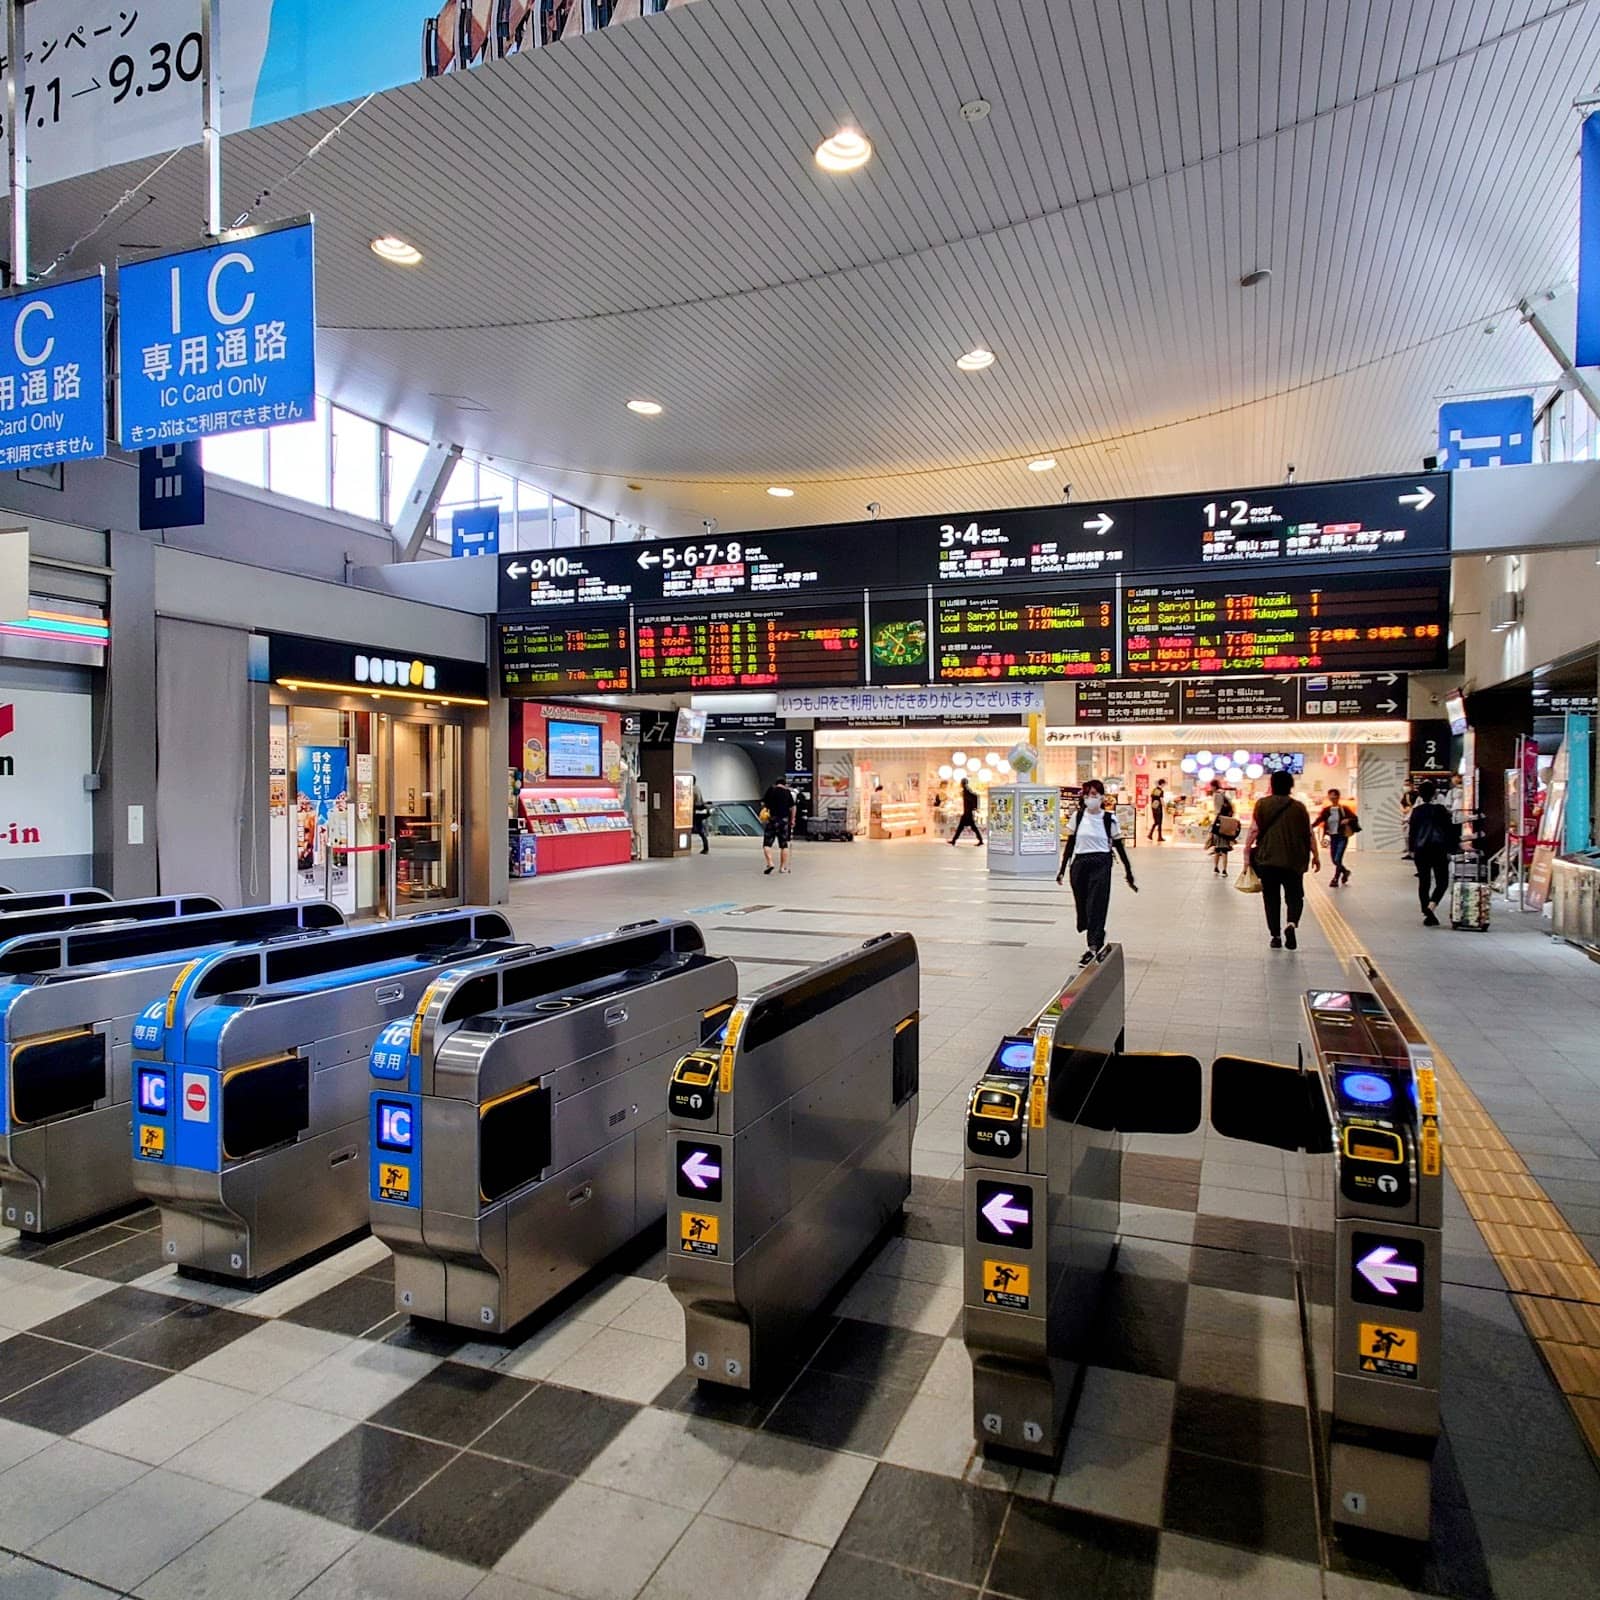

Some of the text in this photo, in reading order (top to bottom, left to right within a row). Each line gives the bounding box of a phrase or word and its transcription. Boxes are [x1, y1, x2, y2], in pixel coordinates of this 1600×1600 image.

[109, 32, 202, 104] 9.30
[141, 321, 287, 382] 専用通路
[161, 373, 267, 407] IC Card Only
[30, 410, 64, 434] Only
[131, 403, 303, 442] きっぷはご利用できません
[940, 612, 960, 623] Local
[1000, 609, 1018, 619] Line
[1100, 604, 1109, 615] 3
[1128, 603, 1149, 614] Local
[1195, 600, 1215, 610] Line
[1128, 615, 1149, 626] Local
[1195, 612, 1215, 622] Line
[1253, 608, 1298, 620] Fukuyama
[940, 623, 960, 634] Local
[1000, 620, 1018, 631] Line
[1100, 616, 1109, 627] 3
[1100, 651, 1109, 662] 3
[1128, 650, 1149, 661] Local
[1194, 648, 1215, 657] Line
[354, 654, 436, 690] DOUTOR
[781, 690, 1041, 712] いつもJRをご利用いただきありがとうございます。
[795, 736, 802, 748] 5
[1425, 740, 1436, 753] 3
[794, 748, 803, 759] 6
[794, 760, 803, 771] 8
[1424, 756, 1436, 769] 4
[133, 1025, 158, 1042] 専用
[372, 1051, 401, 1071] 専用
[142, 1075, 165, 1107] IC
[383, 1108, 411, 1143] IC
[233, 1257, 238, 1265] 4
[403, 1293, 410, 1302] 4
[483, 1310, 490, 1320] 3
[698, 1356, 705, 1366] 3
[729, 1363, 736, 1373] 2
[989, 1418, 997, 1429] 2
[1028, 1427, 1034, 1438] 1
[1351, 1497, 1358, 1509] 1
